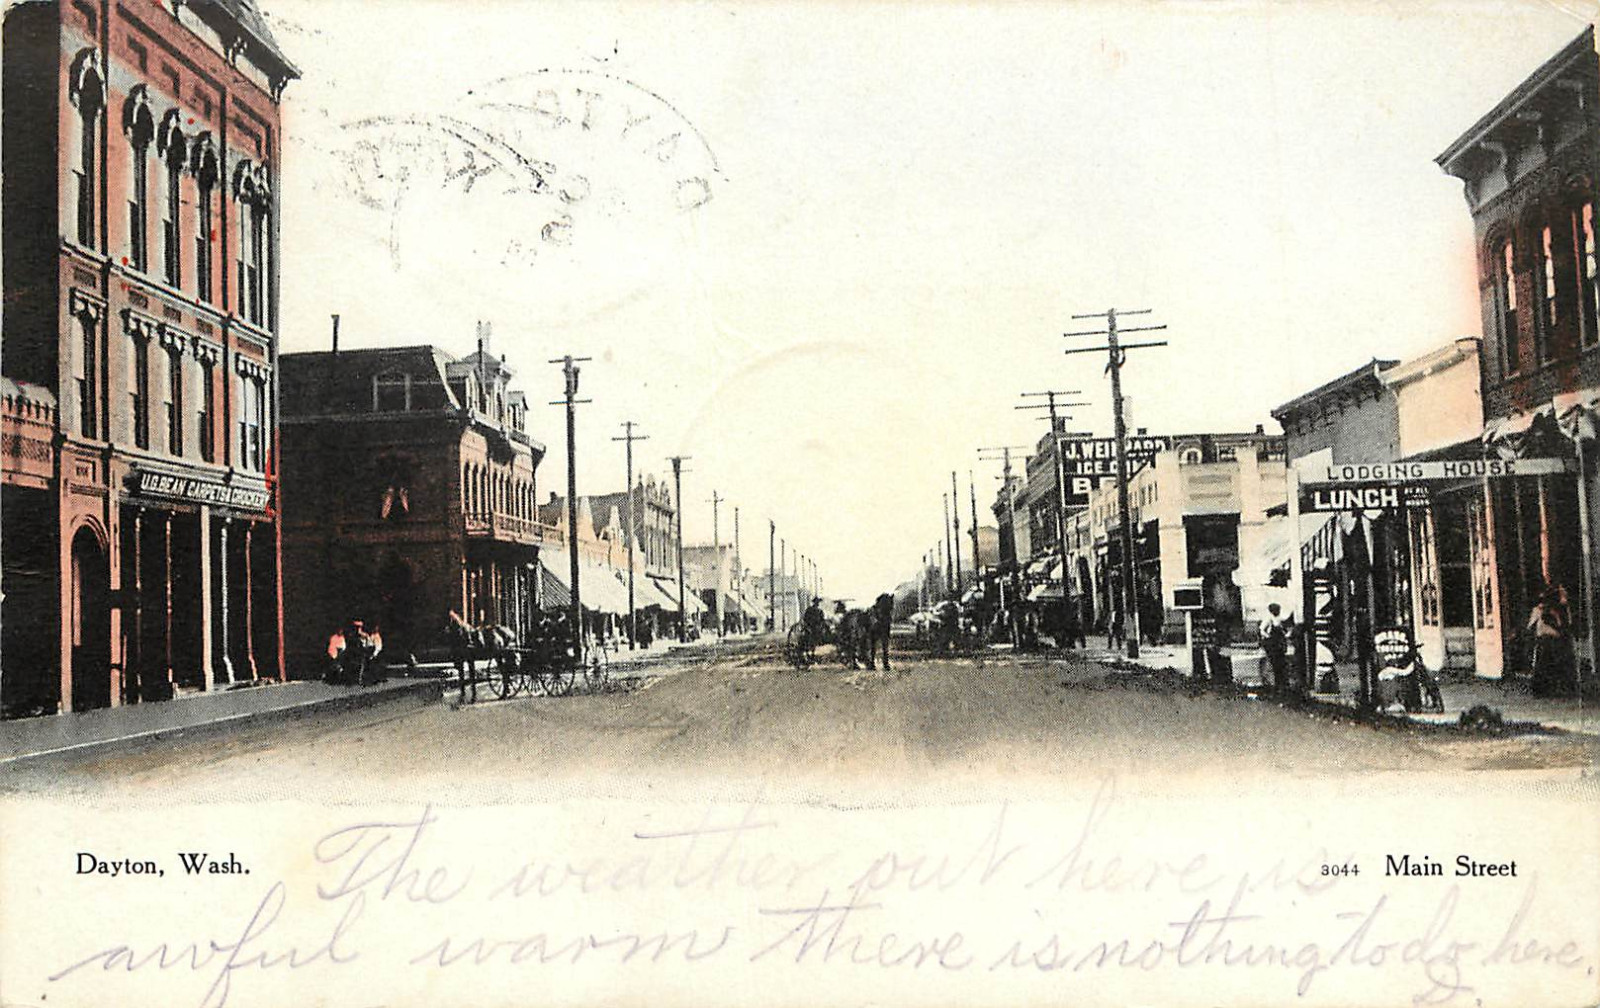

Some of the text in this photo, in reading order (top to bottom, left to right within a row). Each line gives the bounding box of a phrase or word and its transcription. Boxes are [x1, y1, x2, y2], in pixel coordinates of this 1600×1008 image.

[1314, 488, 1399, 510] LUNCH
[1327, 460, 1517, 480] LODGING HOUSE
[313, 803, 474, 903] The
[490, 788, 840, 898] weather
[849, 800, 1029, 907] out
[1024, 775, 1226, 893] here
[49, 881, 360, 1008] awful
[410, 926, 735, 966] warm
[749, 888, 975, 971] there
[990, 908, 1070, 971] is
[1073, 874, 1330, 997] nothing
[1331, 893, 1400, 967] to
[1402, 884, 1480, 965] do
